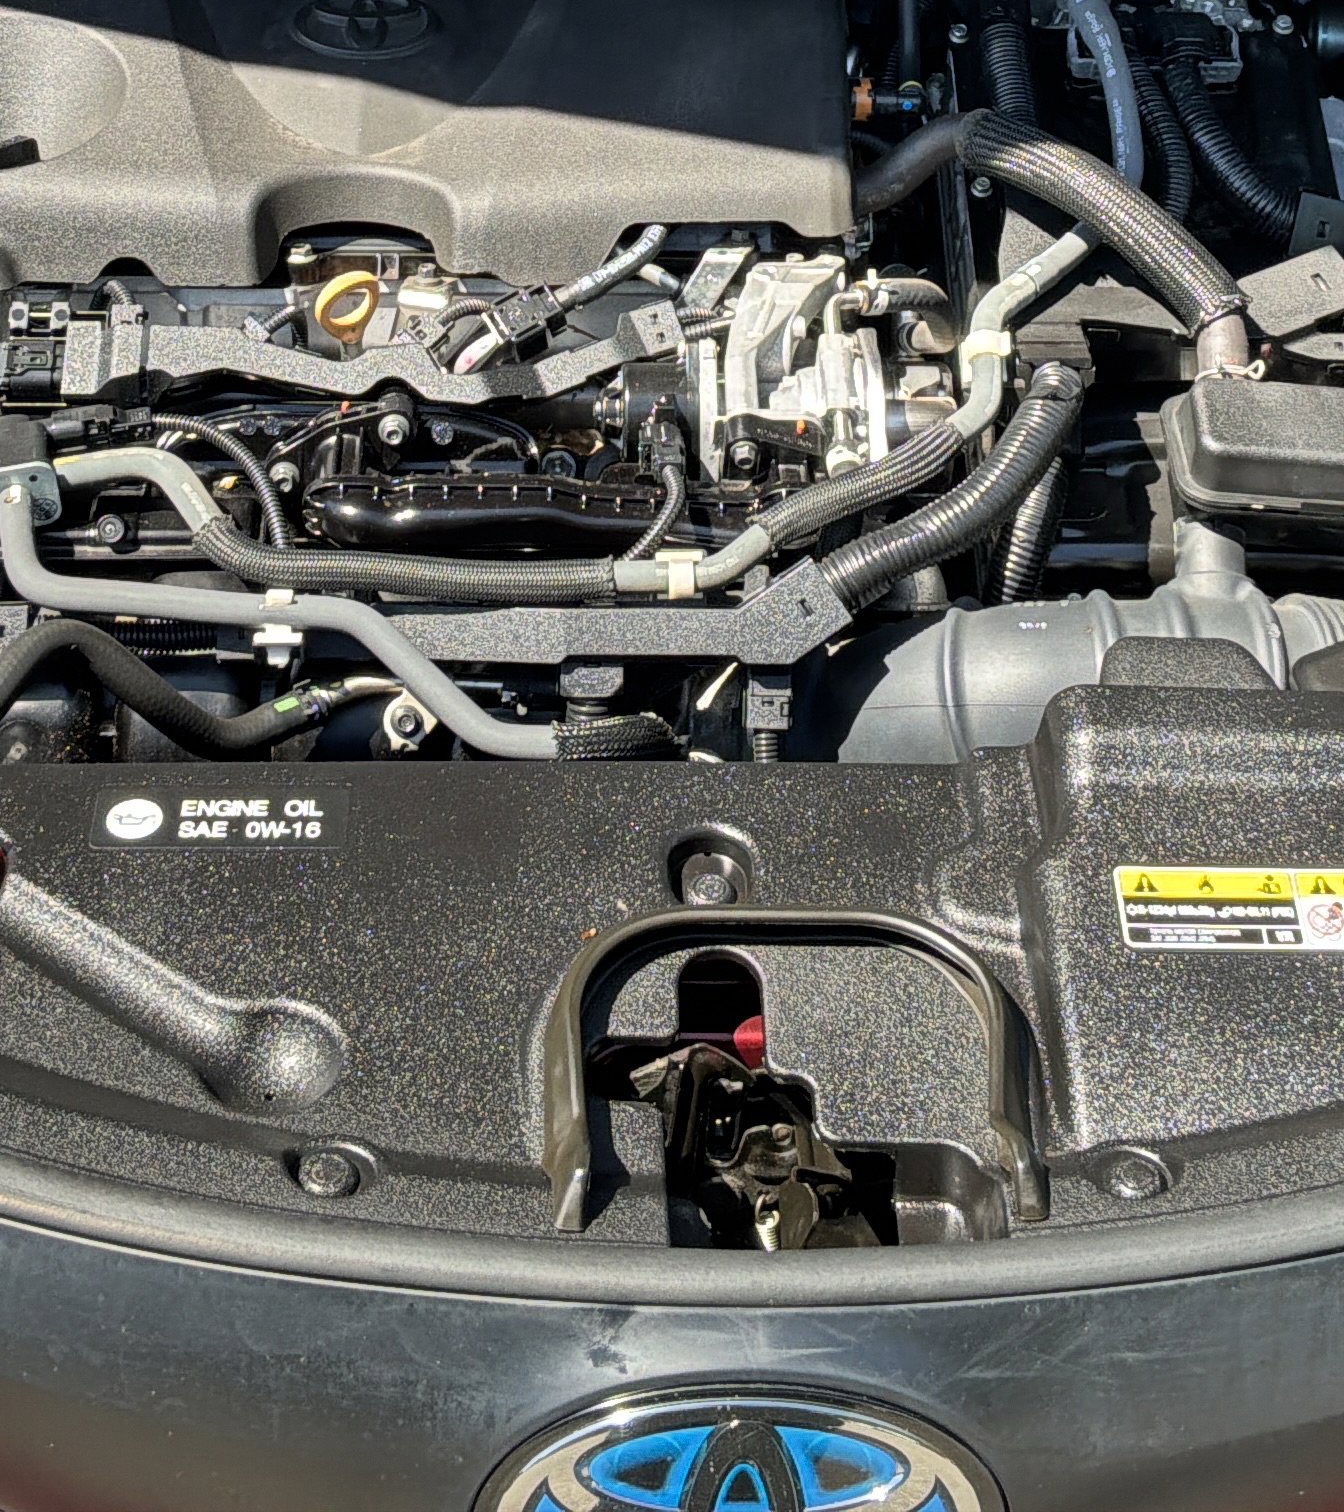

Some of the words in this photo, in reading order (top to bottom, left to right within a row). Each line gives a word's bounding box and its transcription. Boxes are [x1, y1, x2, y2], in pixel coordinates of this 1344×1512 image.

[179, 799, 270, 818] ENGINE
[284, 799, 324, 818] OIL
[177, 820, 229, 839] SAE
[244, 820, 322, 839] 0W-16
